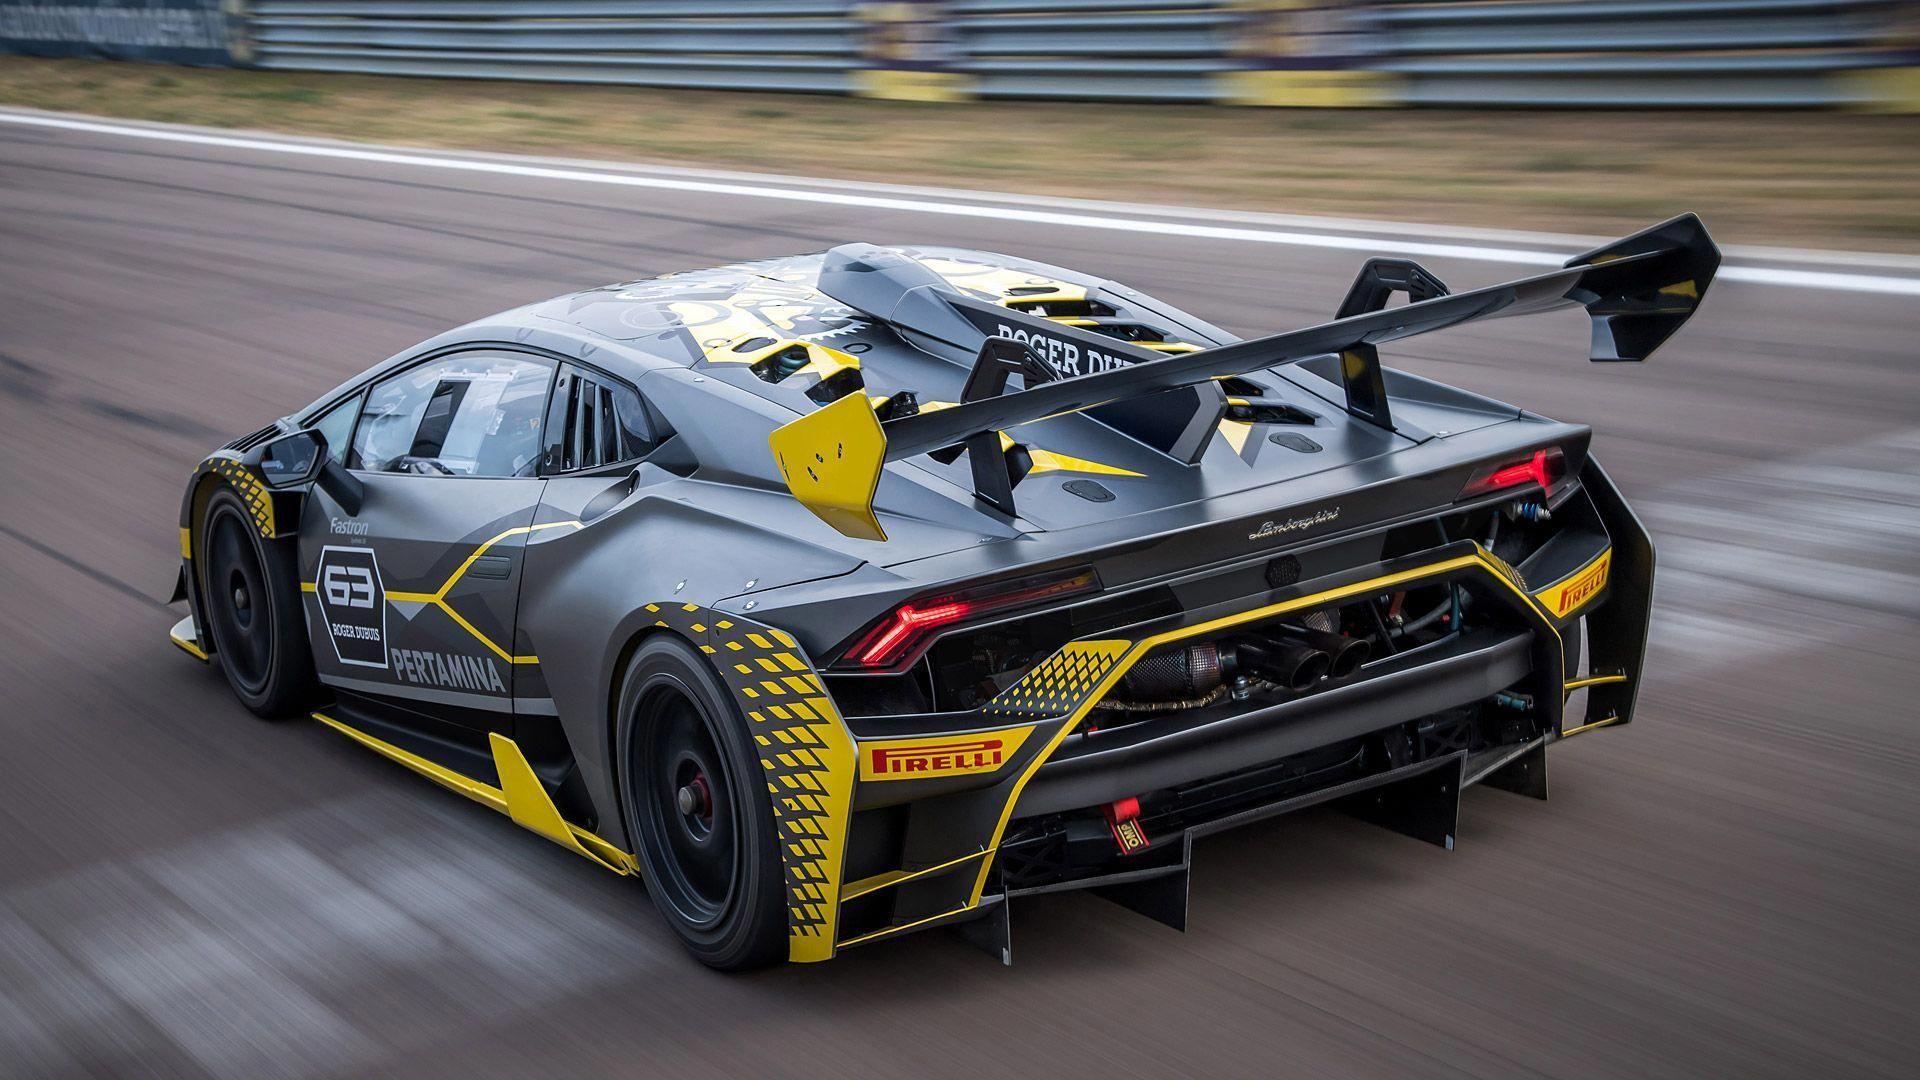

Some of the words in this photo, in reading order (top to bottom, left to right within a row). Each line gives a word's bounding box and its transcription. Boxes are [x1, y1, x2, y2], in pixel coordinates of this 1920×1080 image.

[331, 517, 369, 535] Fastron
[1248, 506, 1340, 540] Lamborghini
[324, 565, 375, 609] 63
[1558, 559, 1607, 613] PIRELLI
[332, 623, 355, 638] ROGER
[355, 626, 380, 641] DUBUIS
[391, 648, 506, 692] PERTAMINA
[872, 740, 1003, 774] PIRELLI
[1120, 824, 1139, 847] OMP
